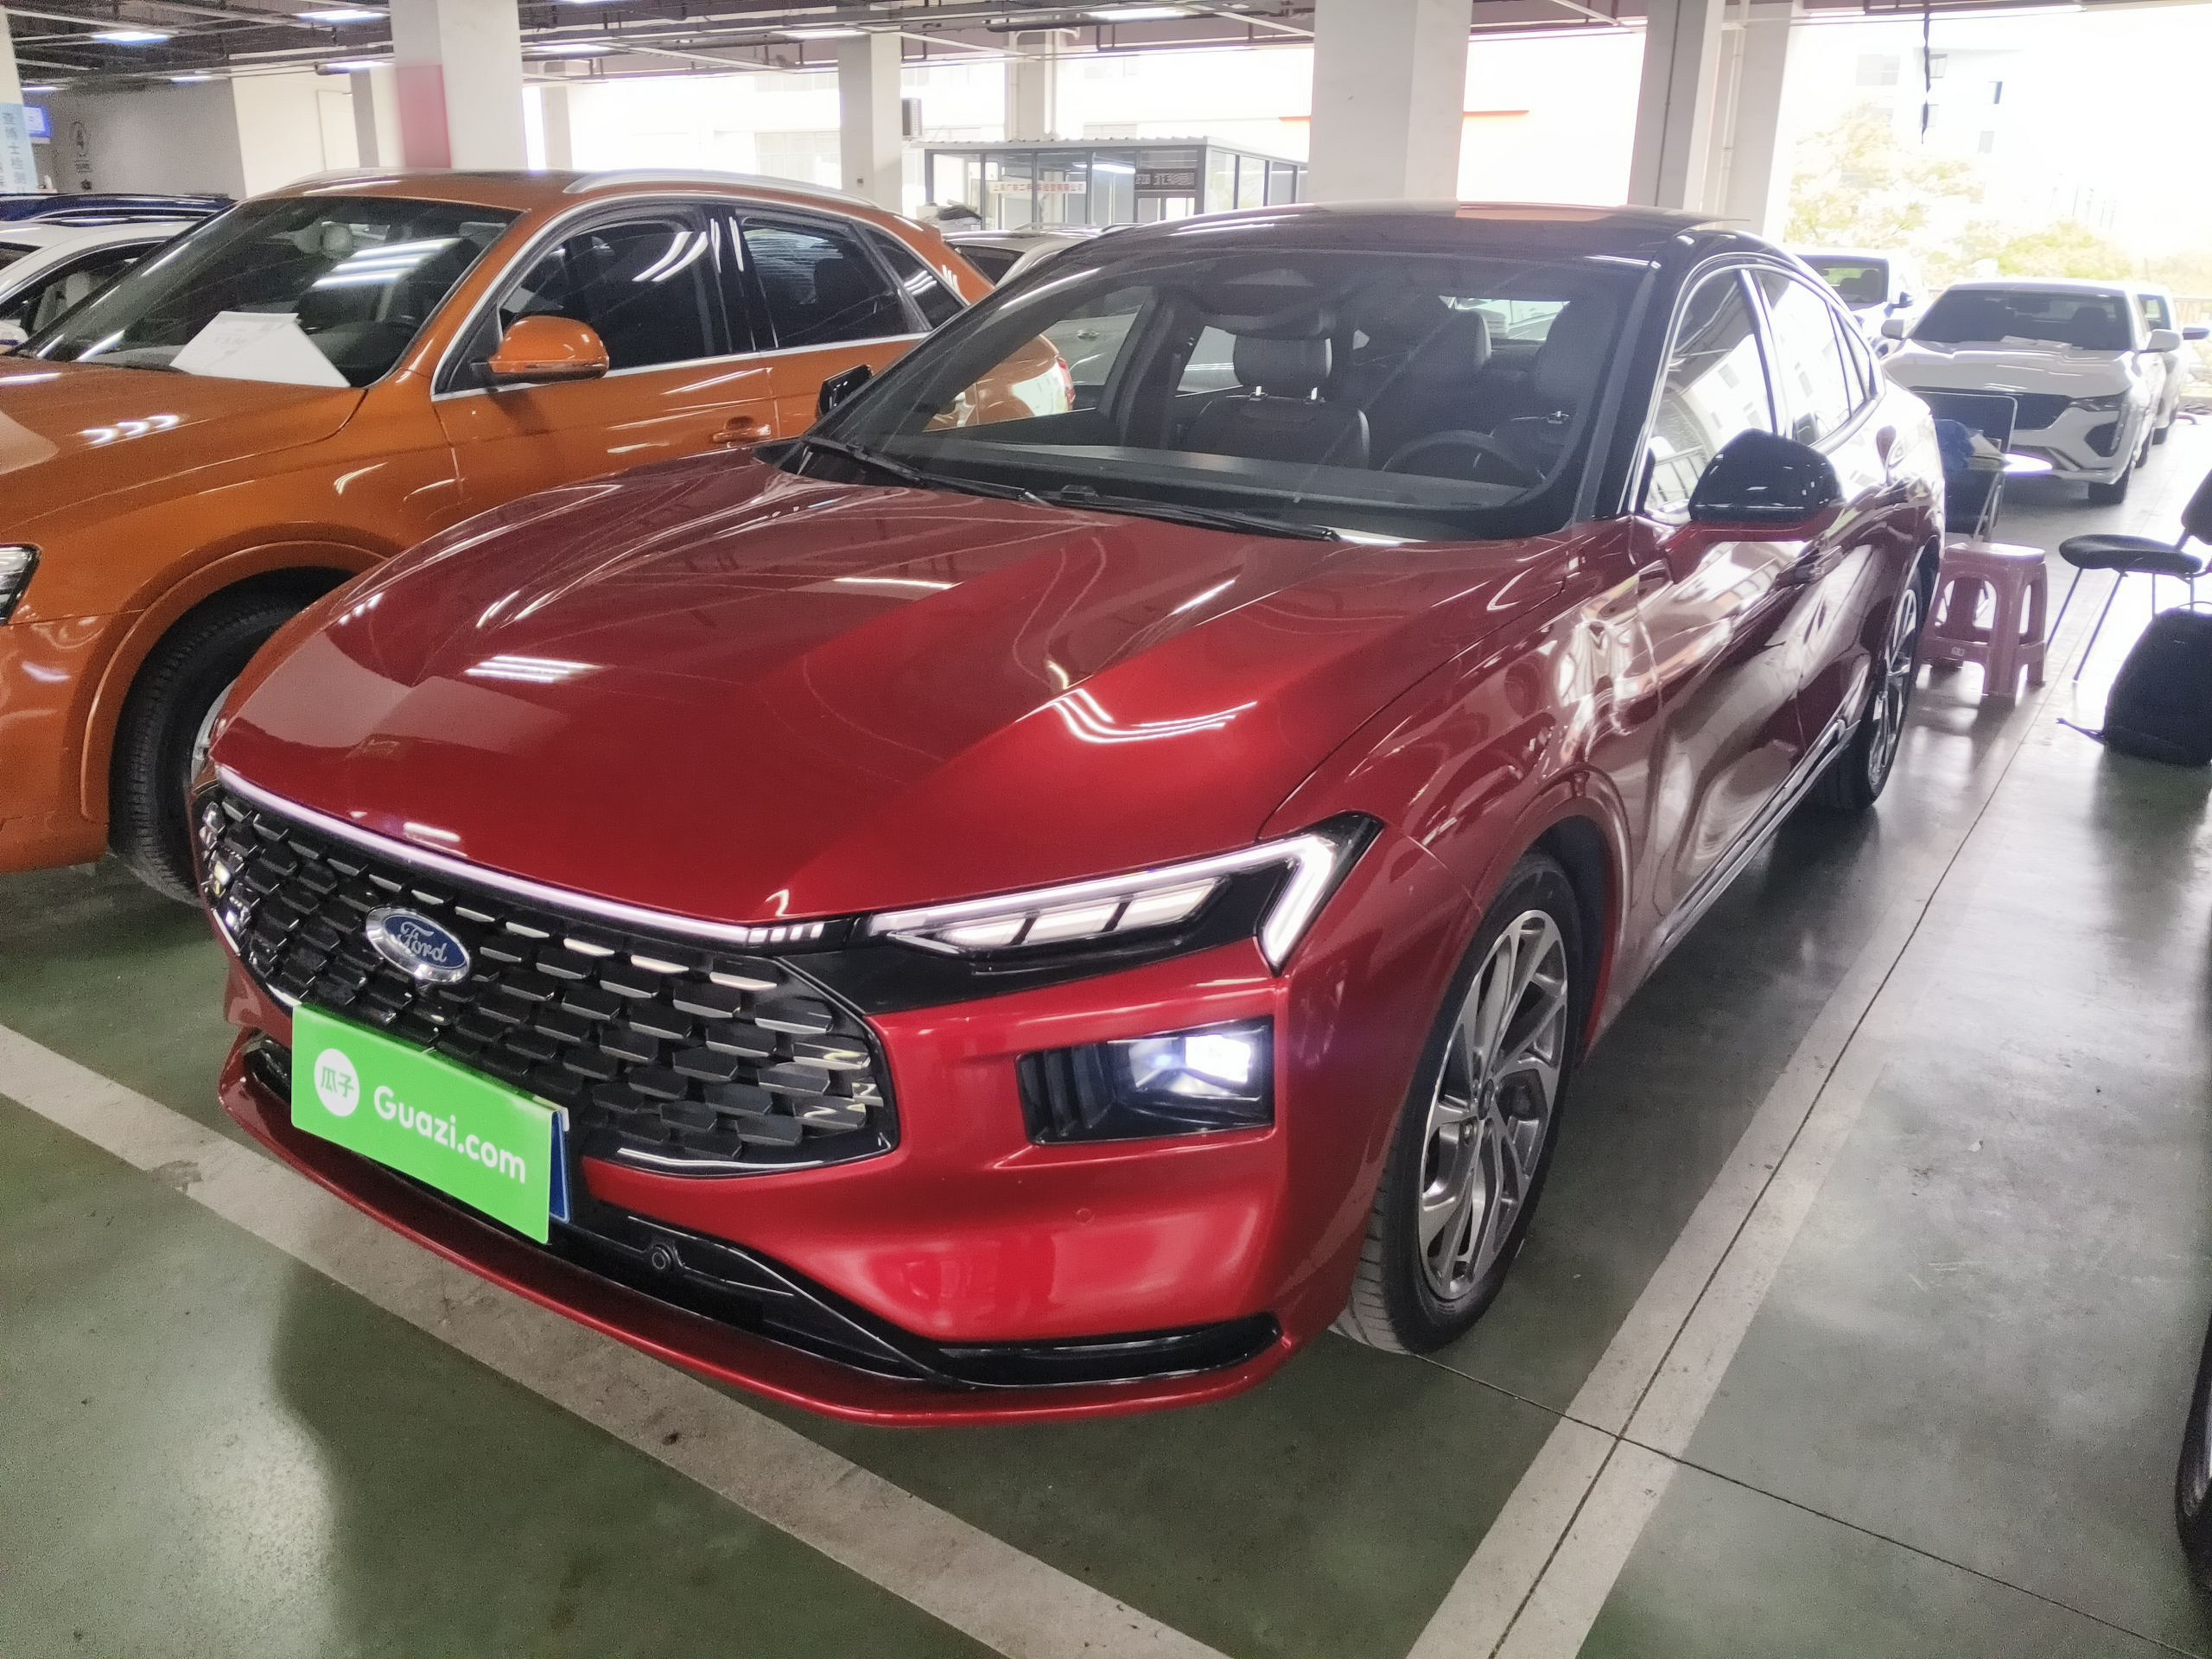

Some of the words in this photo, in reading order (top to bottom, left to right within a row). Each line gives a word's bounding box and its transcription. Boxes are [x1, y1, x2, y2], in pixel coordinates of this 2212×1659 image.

[397, 921, 448, 963] Ford
[320, 1066, 355, 1099] 瓜子
[373, 1085, 527, 1184] Guazi.com
